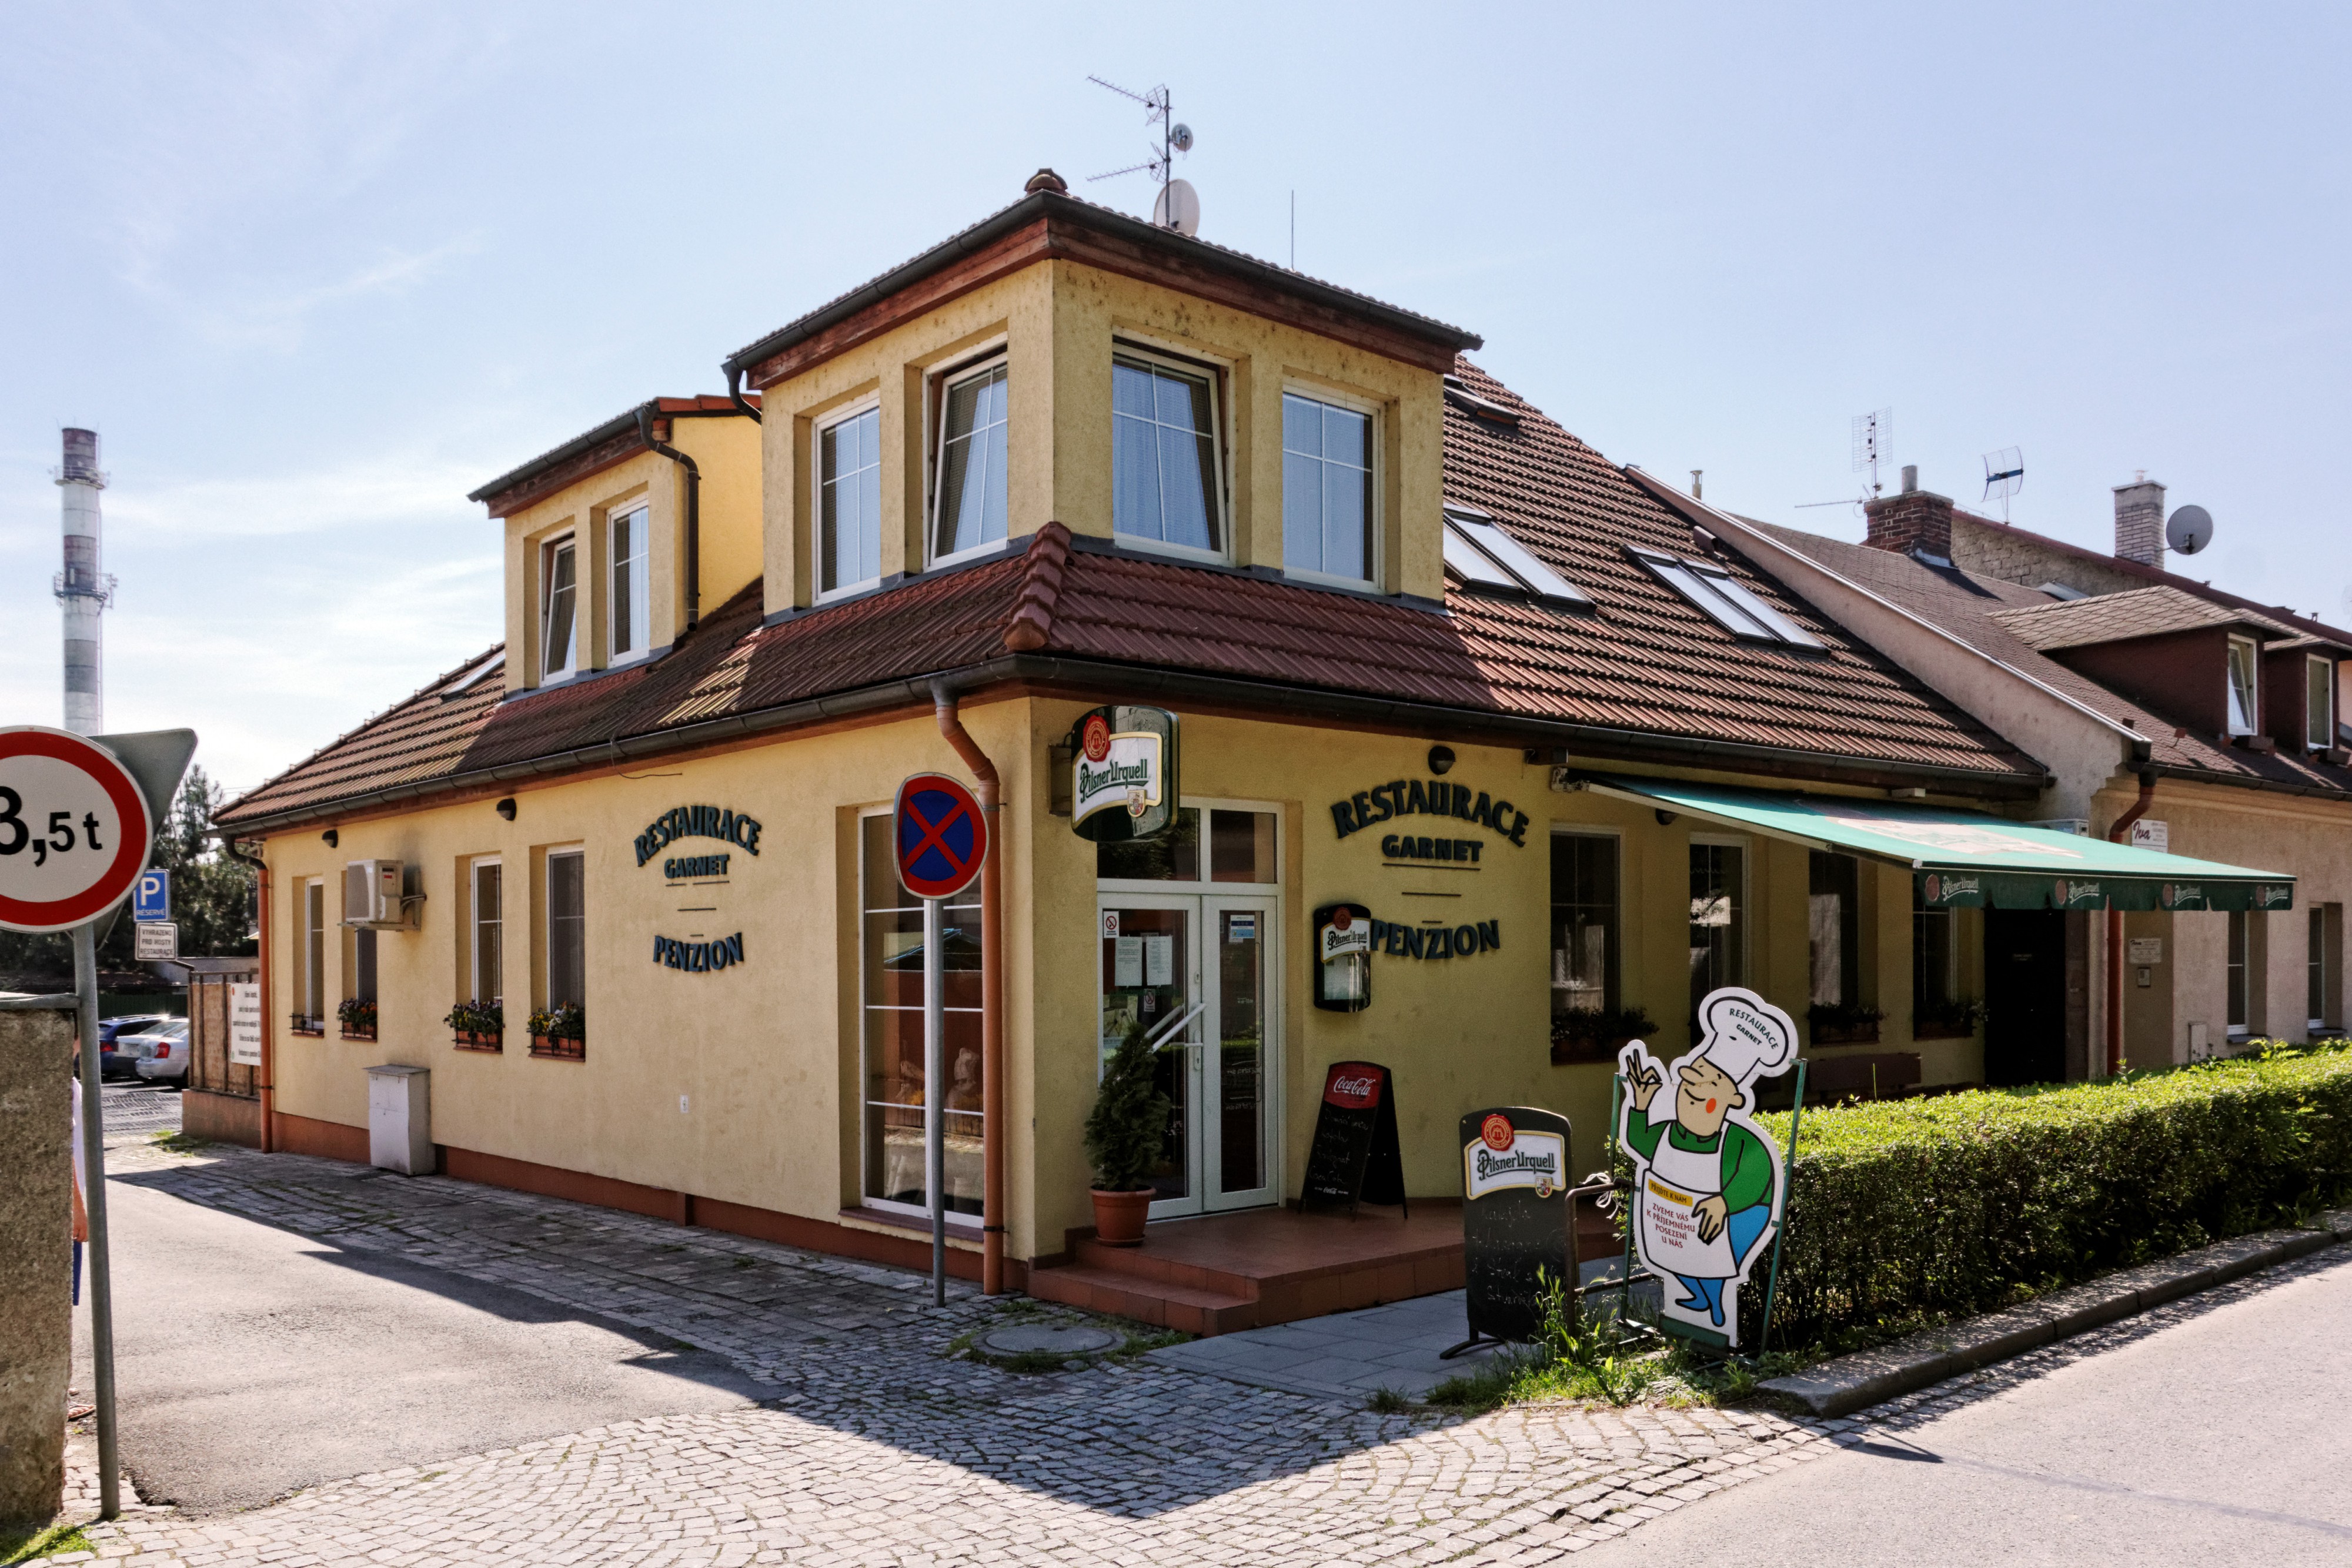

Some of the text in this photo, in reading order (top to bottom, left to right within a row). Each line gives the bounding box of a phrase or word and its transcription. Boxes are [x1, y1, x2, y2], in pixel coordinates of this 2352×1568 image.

[1080, 759, 1147, 804] Pilsner Urquell
[1331, 780, 1529, 848] RESTAURACE
[634, 805, 762, 867] RESTAURACE
[1382, 834, 1484, 861] GARNET
[664, 854, 730, 879] GARNET
[141, 877, 161, 906] P
[1942, 875, 1979, 901] Pilsner Urquell
[653, 932, 744, 972] PENZION
[1328, 930, 1351, 951] Pilsner
[1371, 919, 1501, 960] PENZION
[1729, 1008, 1779, 1049] RESTAURACE
[1736, 1024, 1762, 1045] GARNET
[1477, 1149, 1555, 1181] Pilsner Urquell
[1675, 1194, 1687, 1203] NÁM
[1646, 1209, 1695, 1232] K PŘÍJEMNÉMU
[1653, 1203, 1689, 1221] ZVEME VÁS
[1655, 1223, 1687, 1240] POSEZENÍ
[1662, 1235, 1683, 1248] U NÁS
